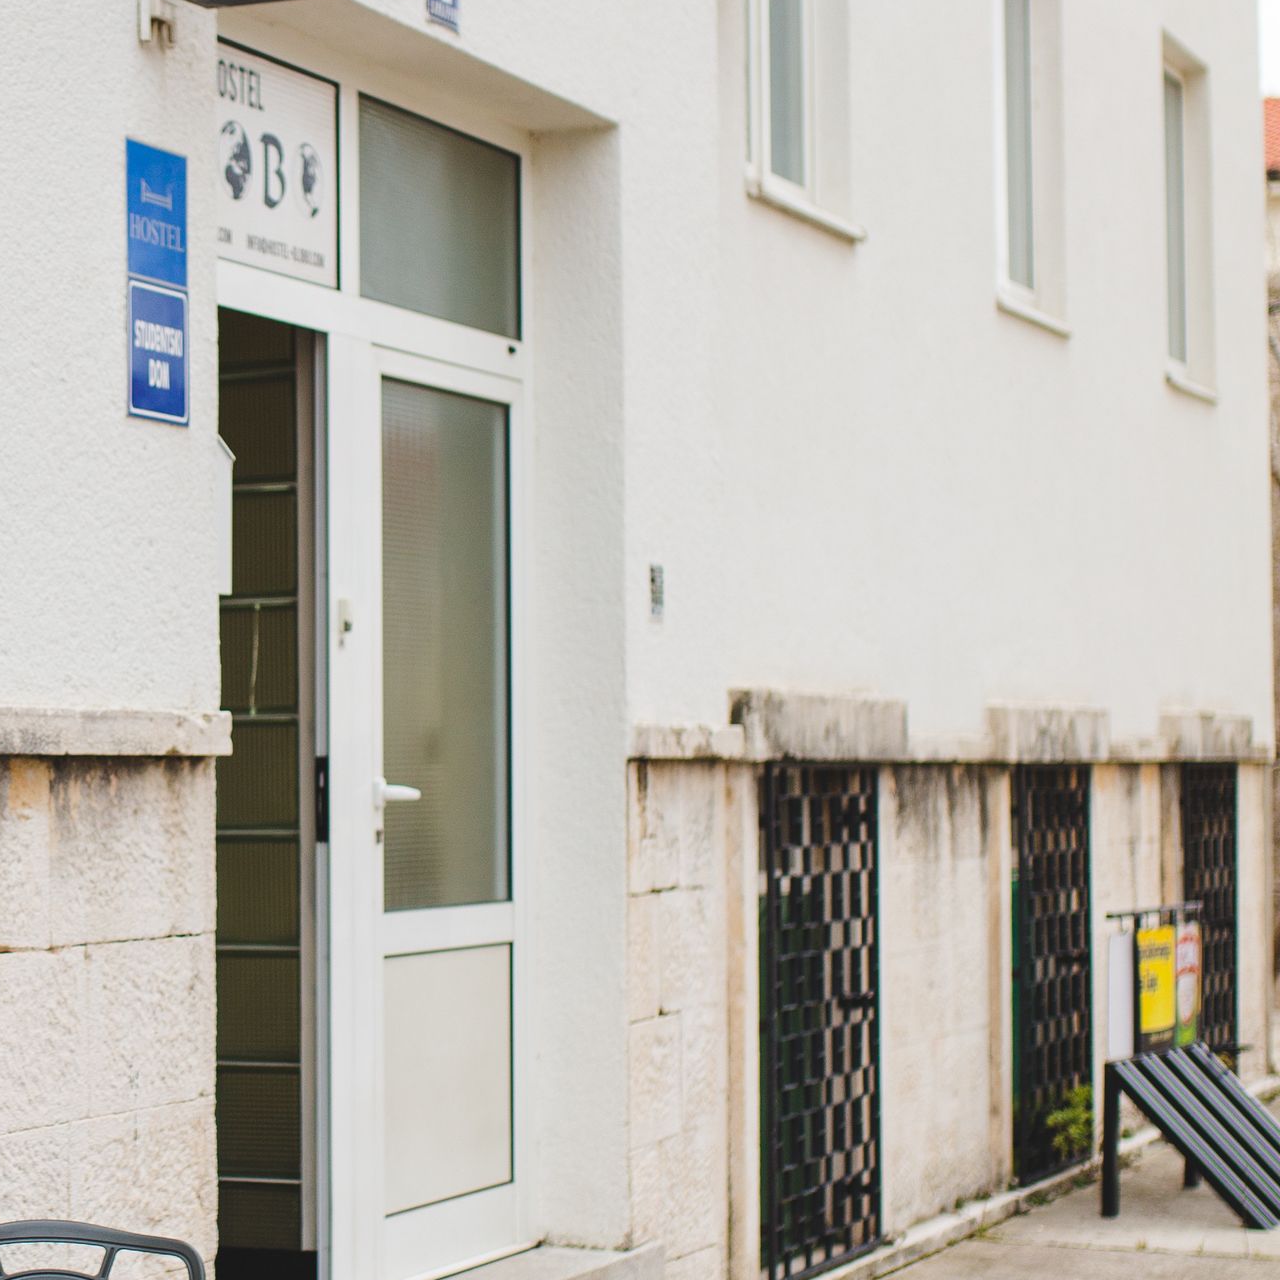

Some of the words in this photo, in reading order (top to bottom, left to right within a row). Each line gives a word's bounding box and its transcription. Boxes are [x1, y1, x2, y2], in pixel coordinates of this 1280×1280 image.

[129, 212, 185, 253] HOSTEL
[134, 319, 184, 357] STUDENTSKI
[148, 358, 171, 391] DOM
